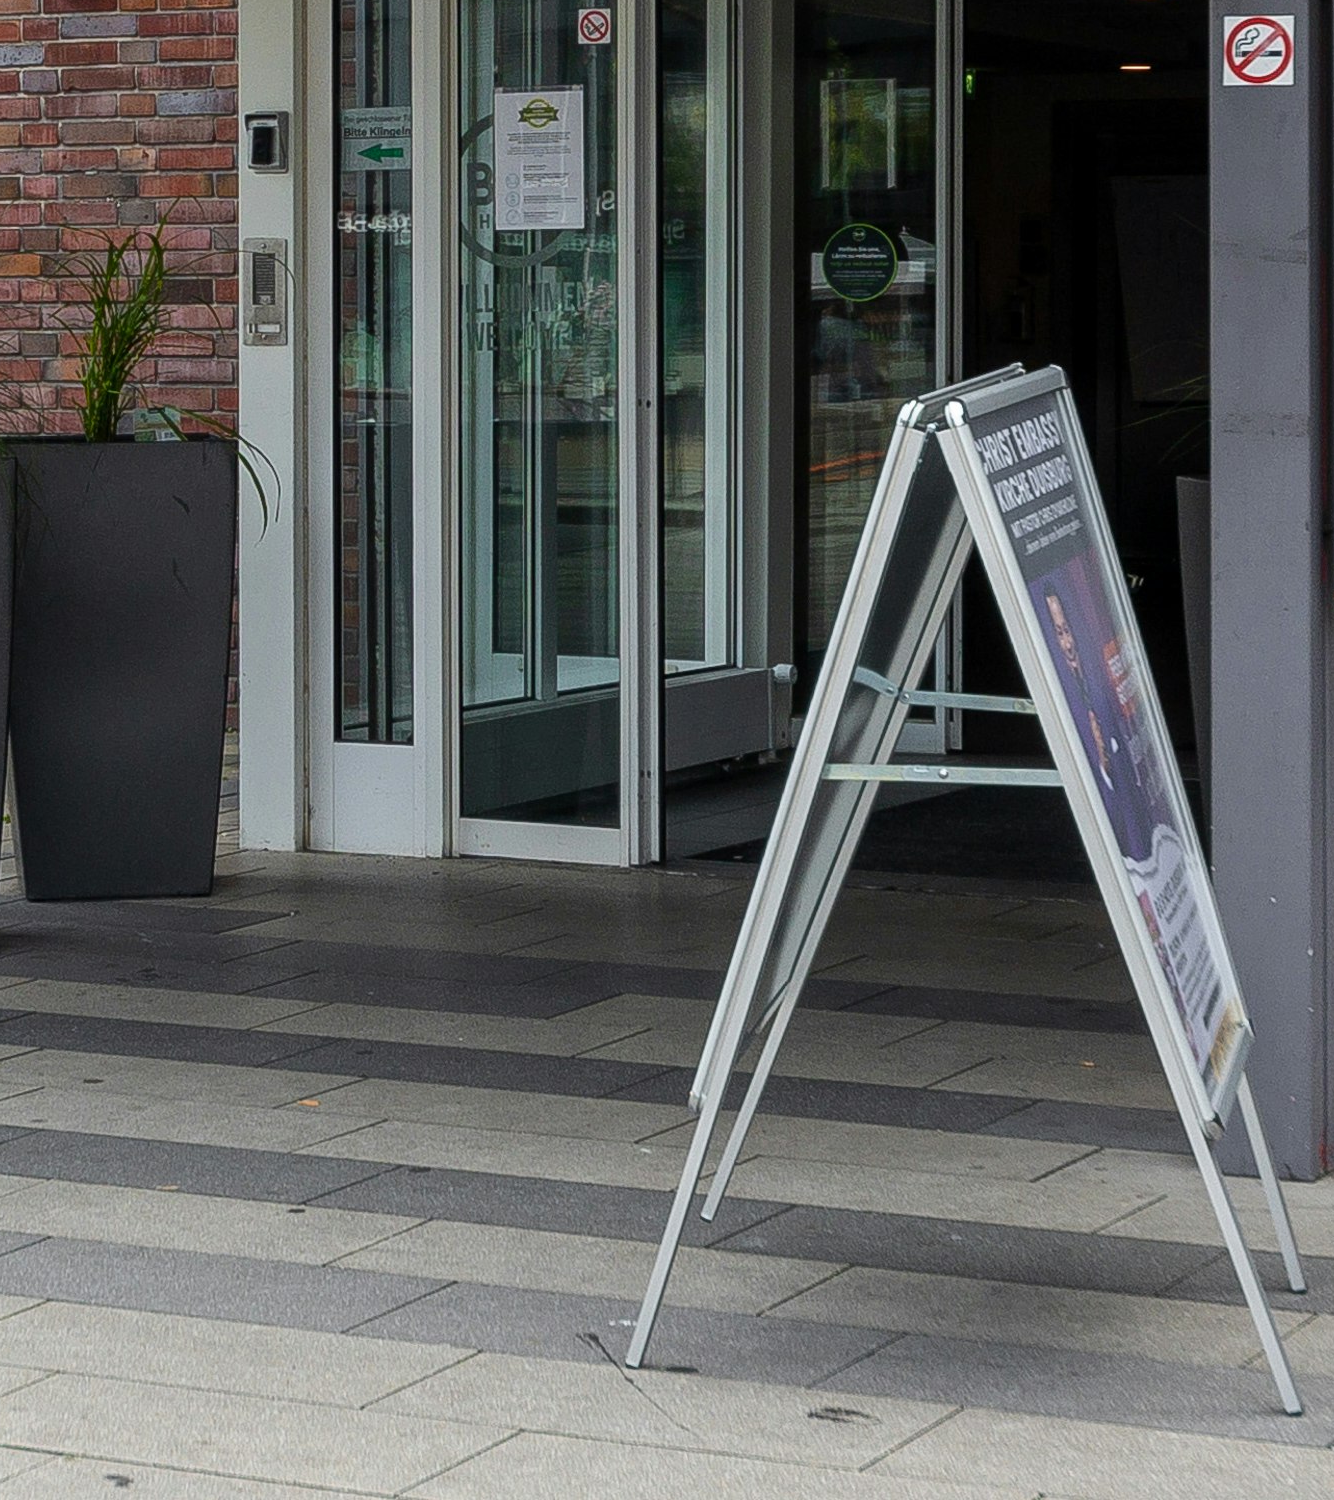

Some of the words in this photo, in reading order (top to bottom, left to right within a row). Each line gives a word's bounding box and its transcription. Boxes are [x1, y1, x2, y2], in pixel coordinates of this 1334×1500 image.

[343, 127, 368, 137] Bitte
[369, 125, 412, 139] Klingeln
[973, 428, 1020, 476] CHRIST
[1010, 410, 1066, 461] EMBASSY
[993, 471, 1035, 514] KIRCHE
[1026, 454, 1074, 498] DUISBURG
